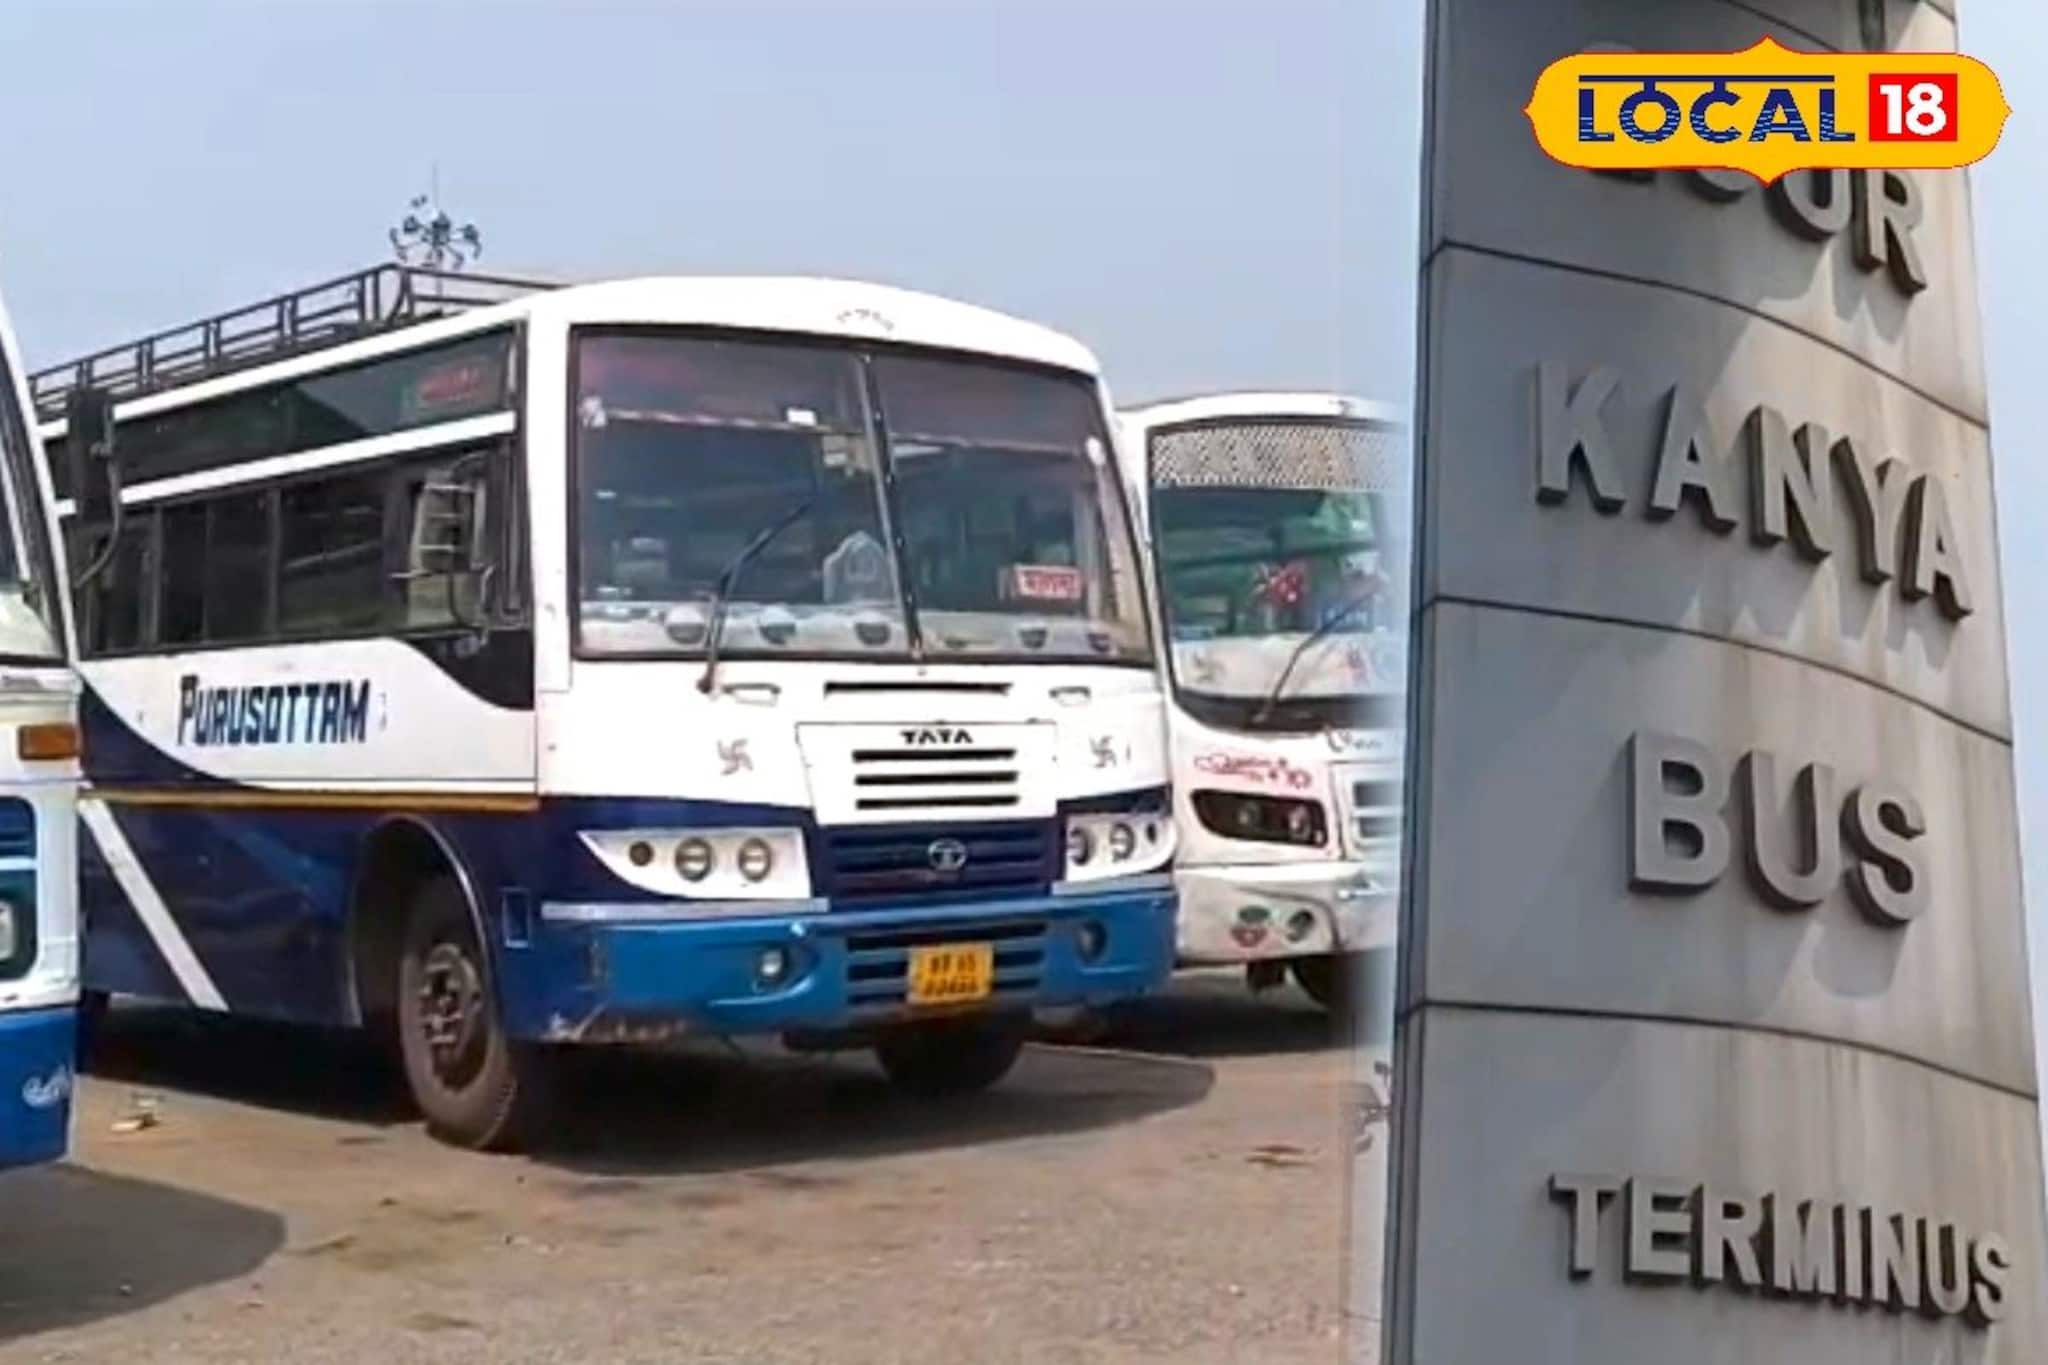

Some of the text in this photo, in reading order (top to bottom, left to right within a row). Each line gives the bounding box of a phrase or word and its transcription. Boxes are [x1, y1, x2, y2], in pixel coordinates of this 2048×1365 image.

[1534, 360, 1975, 622] KANYA
[178, 673, 370, 746] PURUSOTTAM
[900, 728, 973, 745] TATA
[1627, 730, 1932, 927] BUS
[1547, 1171, 2012, 1332] TERMINUS
